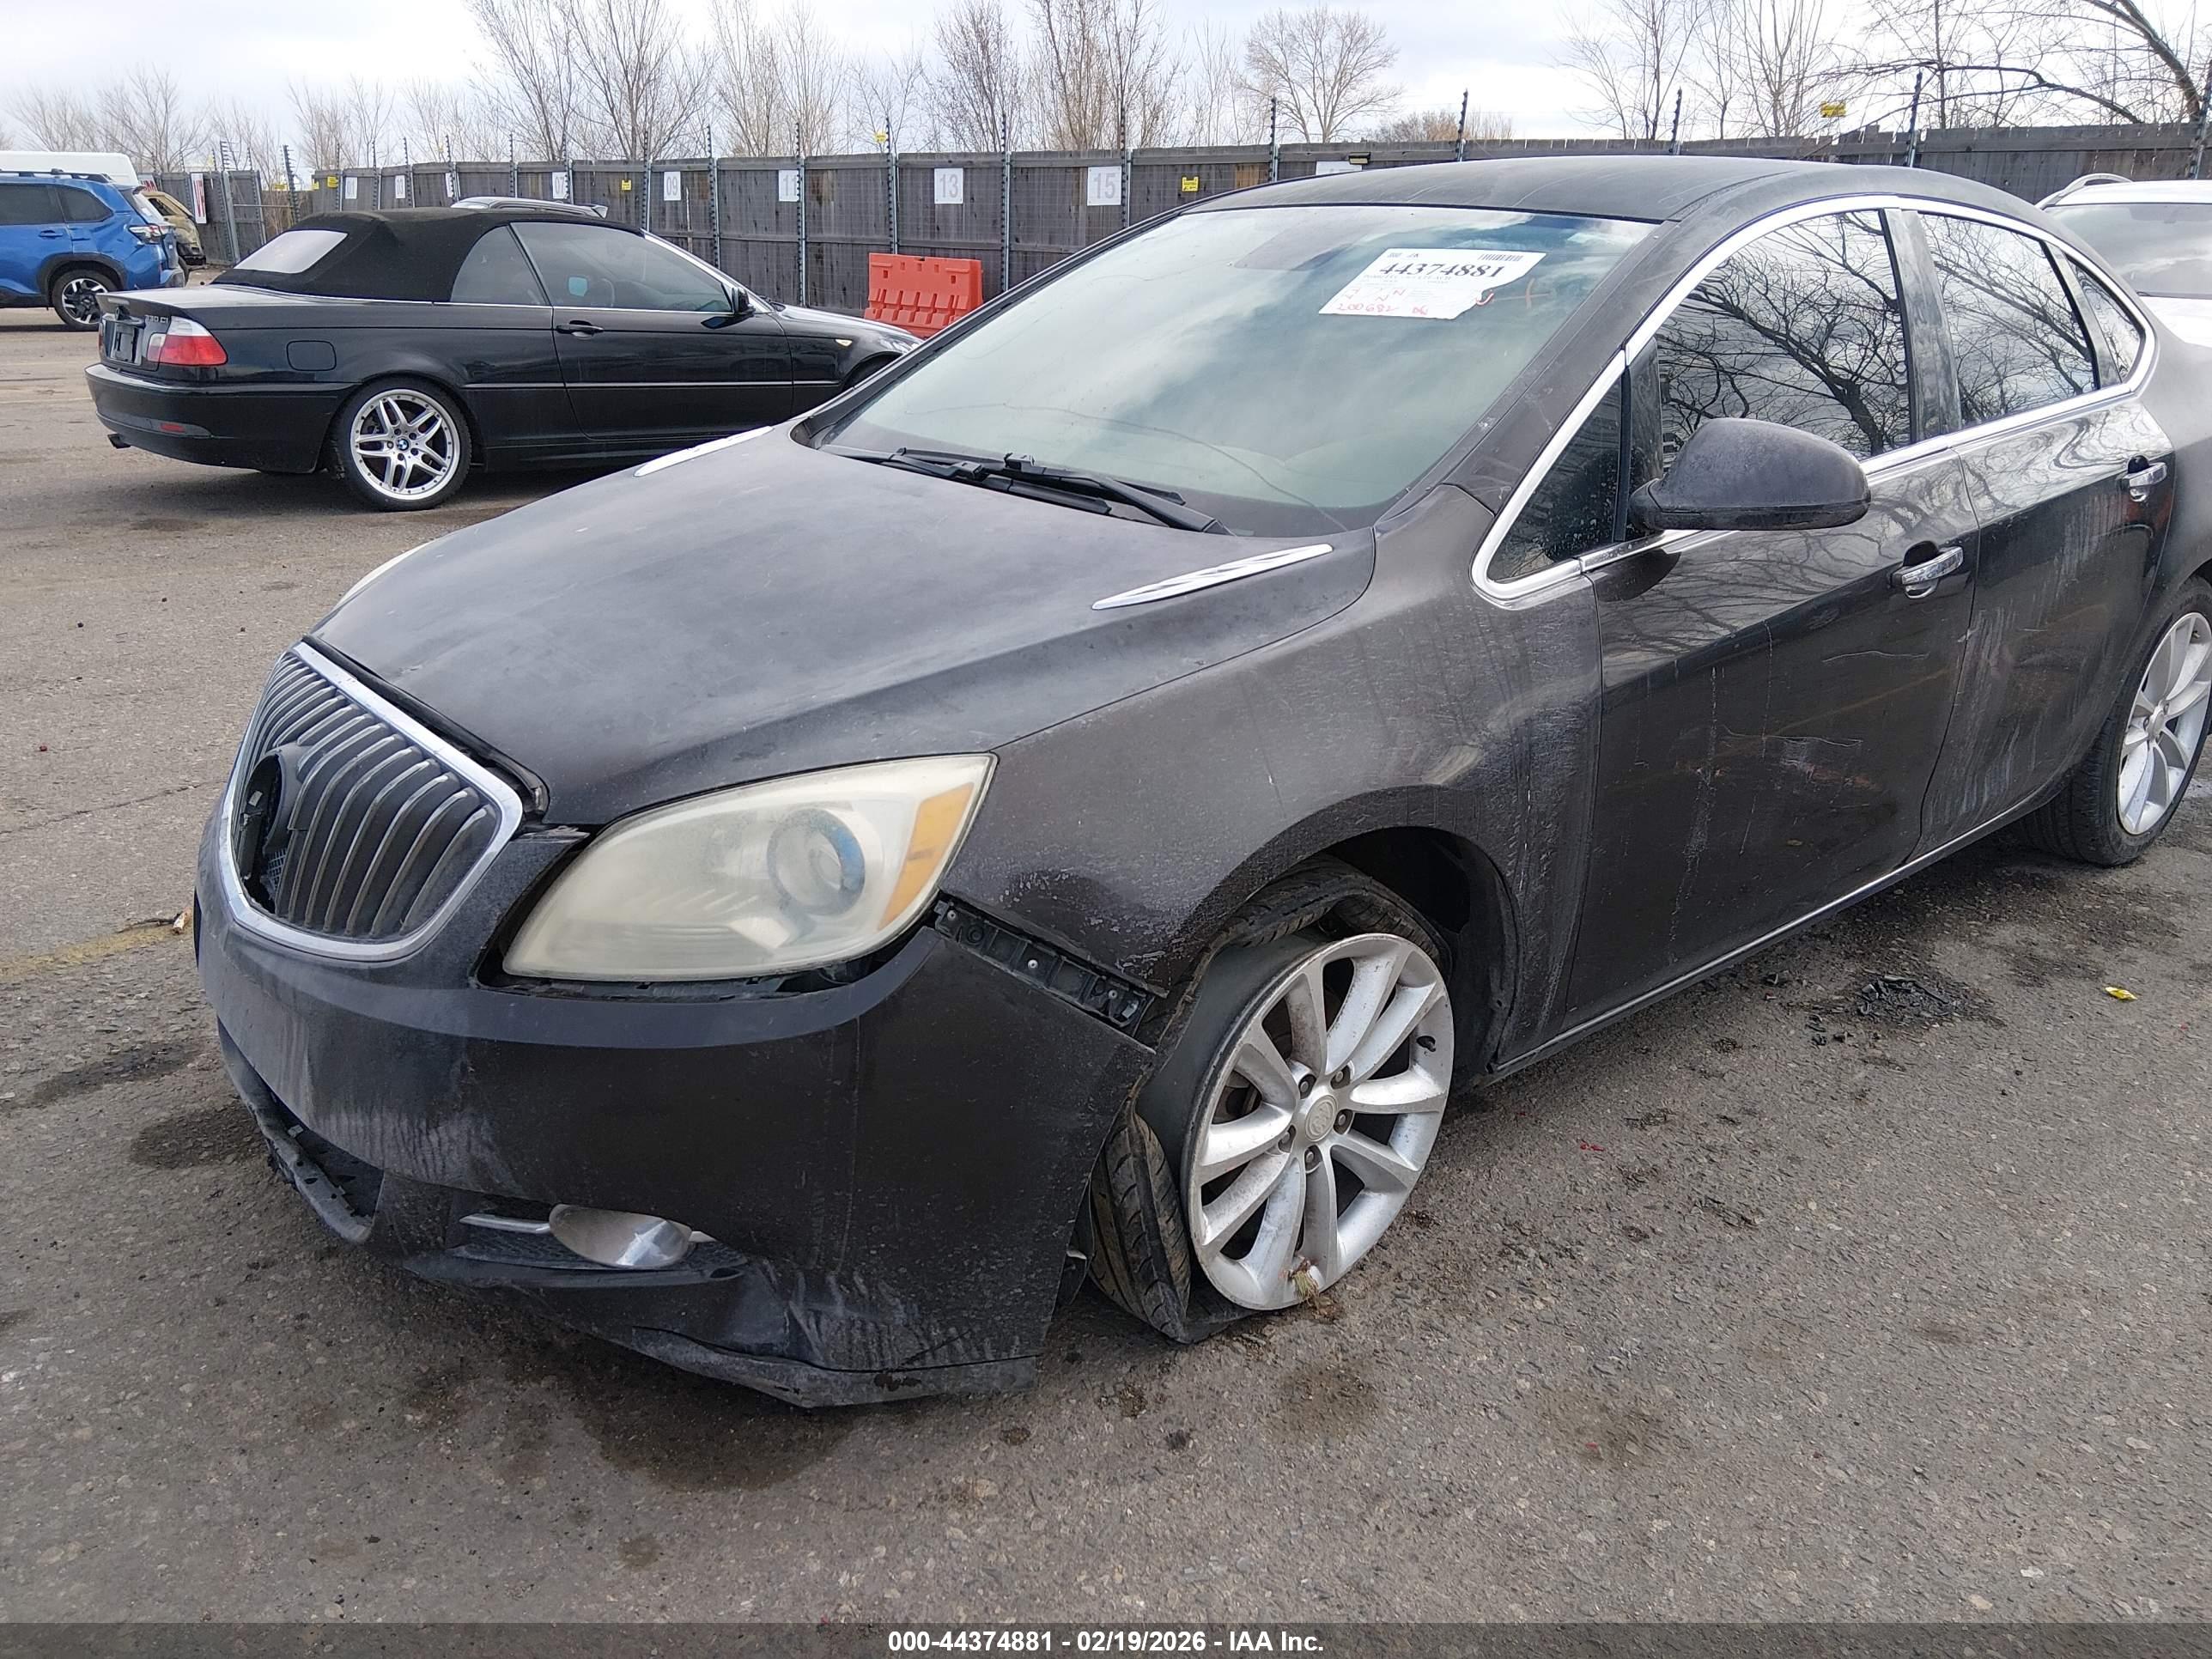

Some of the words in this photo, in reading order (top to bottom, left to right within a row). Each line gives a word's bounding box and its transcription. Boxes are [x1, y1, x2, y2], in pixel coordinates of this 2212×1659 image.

[554, 176, 564, 195] 07
[666, 176, 678, 196] 09
[782, 174, 797, 196] 11
[939, 173, 959, 198] 13
[1093, 173, 1116, 199] 15
[1379, 263, 1504, 277] 44374881
